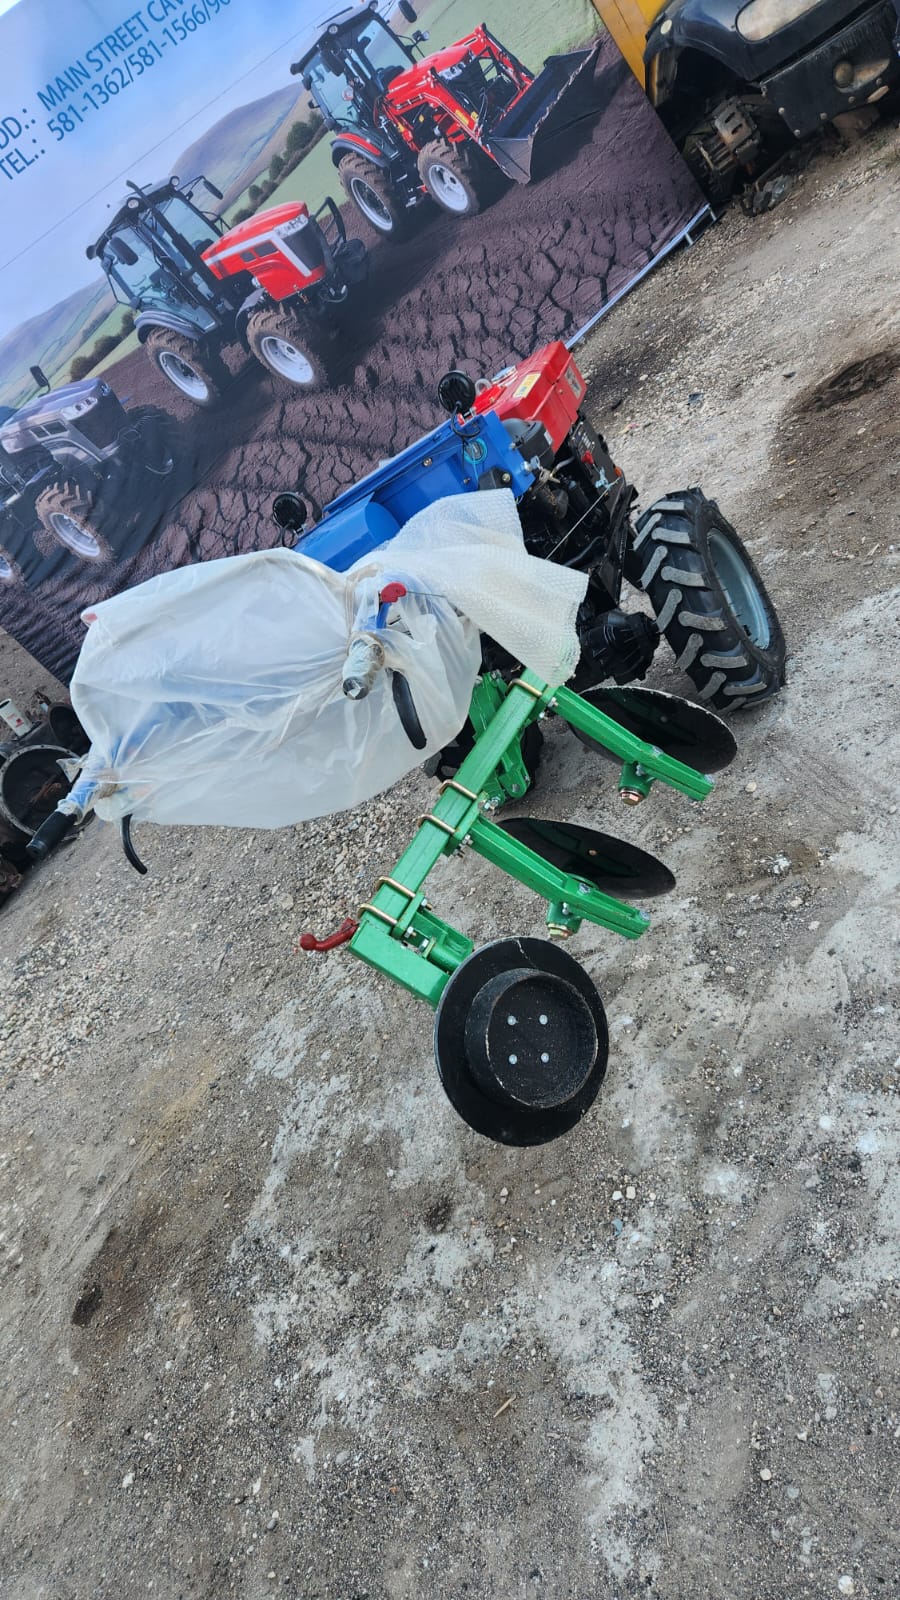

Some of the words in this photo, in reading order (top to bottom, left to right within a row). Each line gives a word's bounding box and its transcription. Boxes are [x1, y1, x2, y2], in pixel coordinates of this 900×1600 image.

[36, 60, 91, 112] MAIN
[85, 11, 149, 73] STREET
[146, 0, 184, 22] CA
[0, 138, 45, 180] TEL.:
